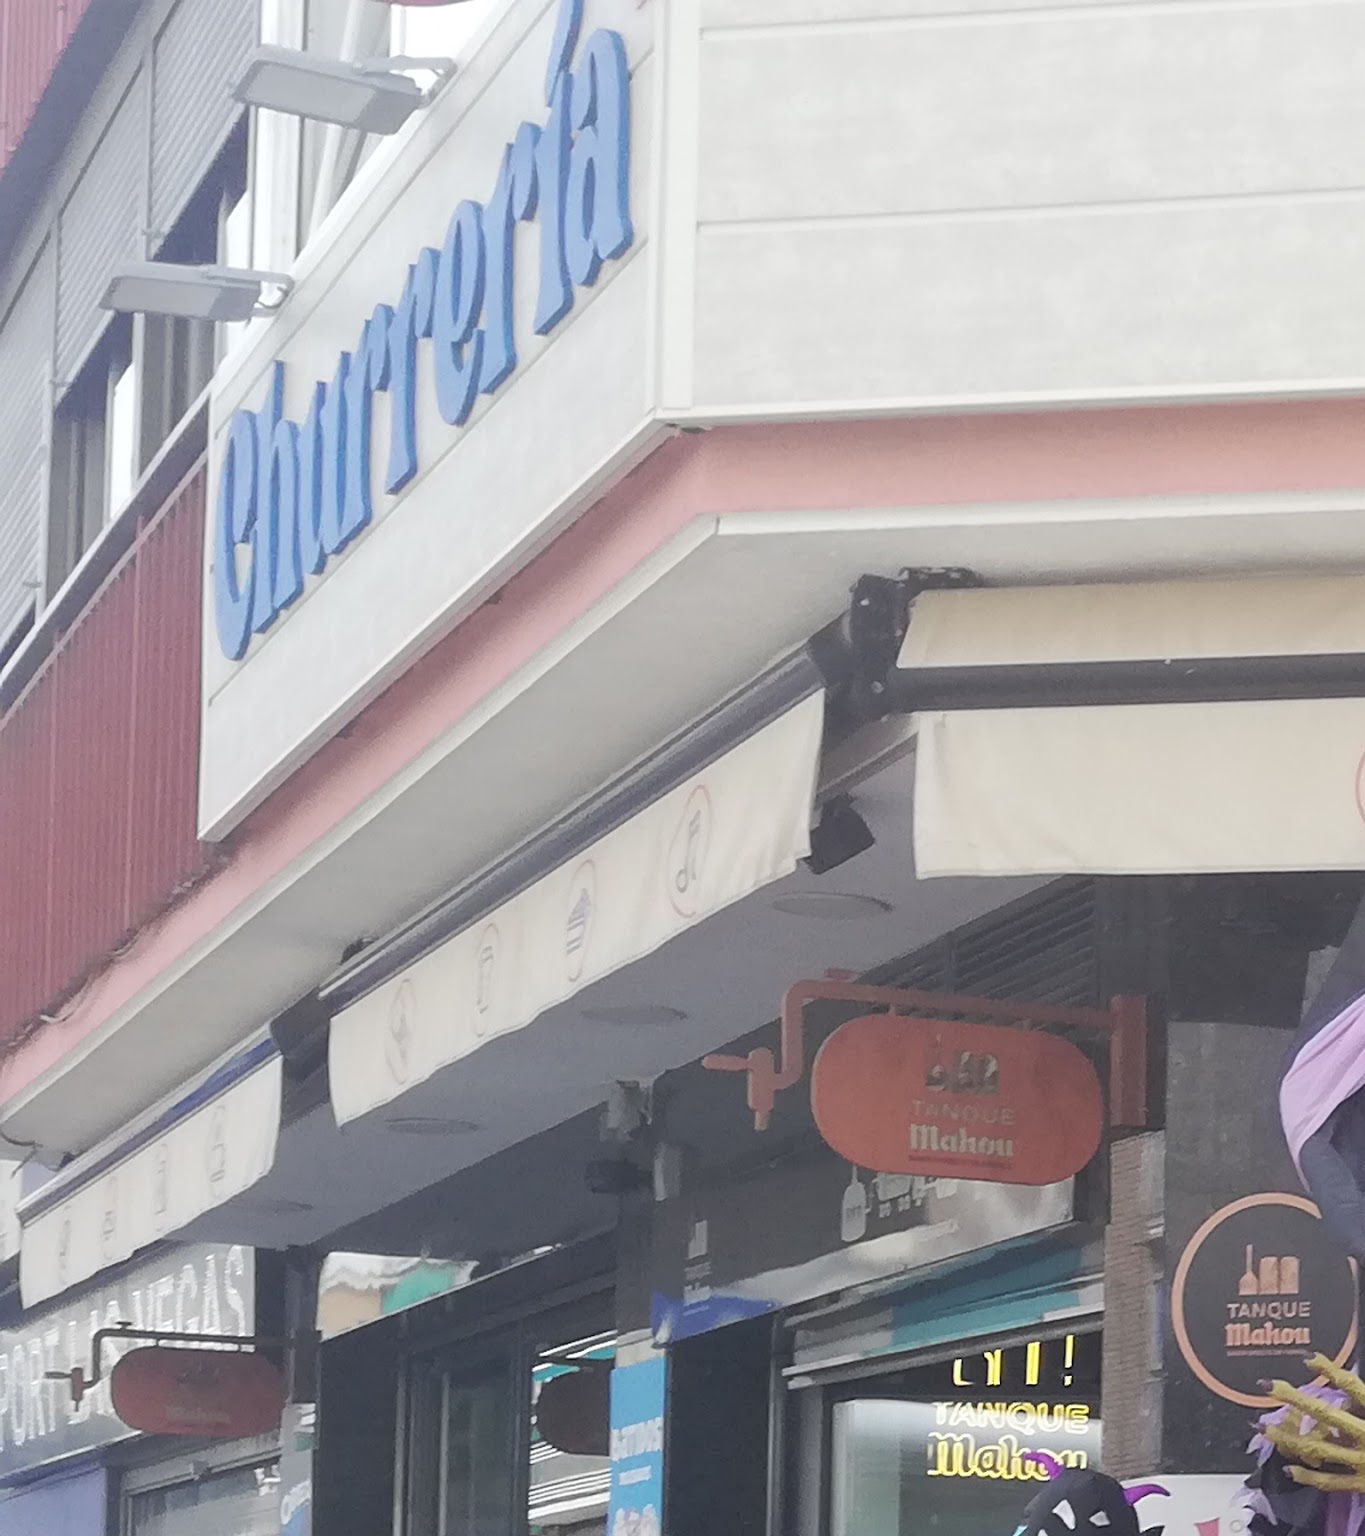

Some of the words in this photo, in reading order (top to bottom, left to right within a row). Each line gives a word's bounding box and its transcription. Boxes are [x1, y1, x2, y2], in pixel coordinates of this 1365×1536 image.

[214, 0, 635, 661] Churrería
[911, 1100, 1016, 1126] TANQUE
[908, 1123, 1015, 1157] Mahou
[1226, 1301, 1312, 1321] TANQUE
[1225, 1321, 1311, 1347] Mahou
[931, 1402, 1090, 1435] TANQUE
